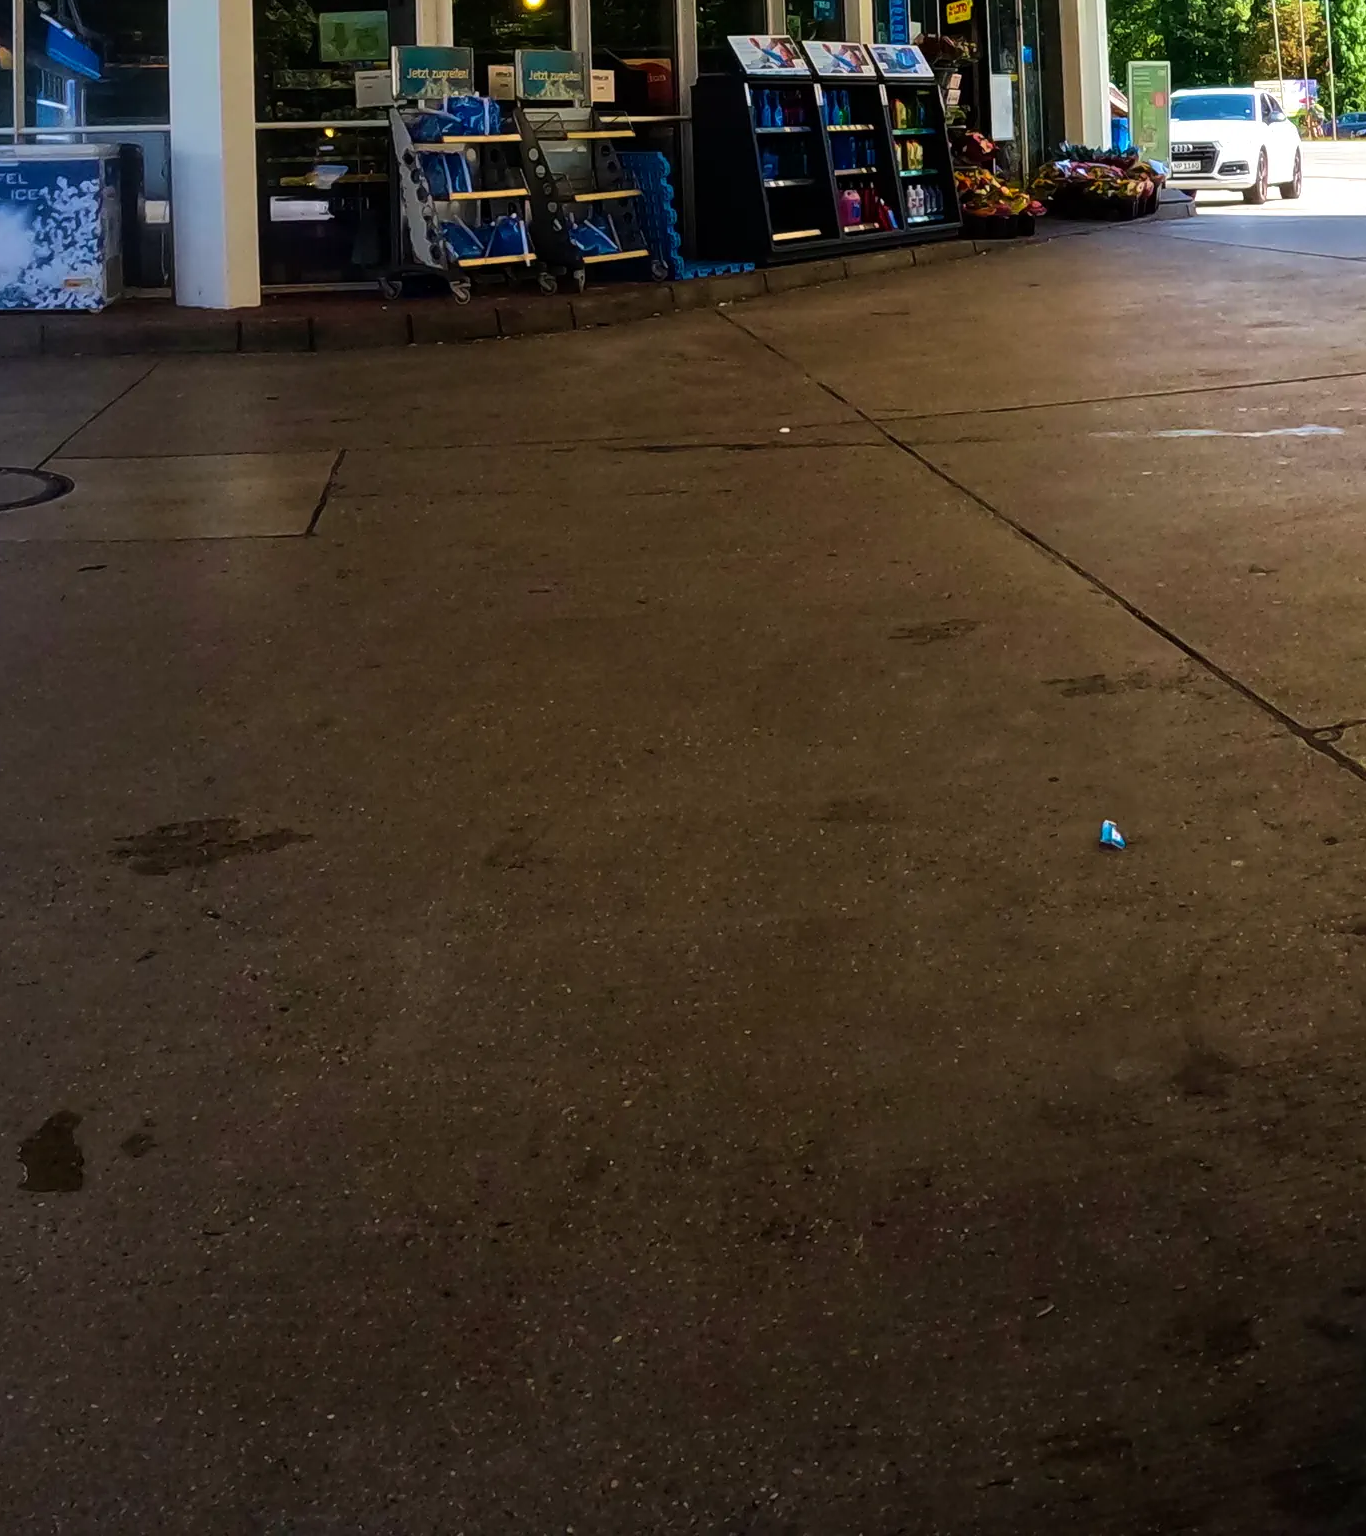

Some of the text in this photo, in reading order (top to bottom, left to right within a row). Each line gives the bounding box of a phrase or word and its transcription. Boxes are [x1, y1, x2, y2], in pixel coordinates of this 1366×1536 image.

[406, 68, 430, 80] Jetzt
[529, 69, 550, 82] Jetzt
[10, 188, 40, 201] ICE
